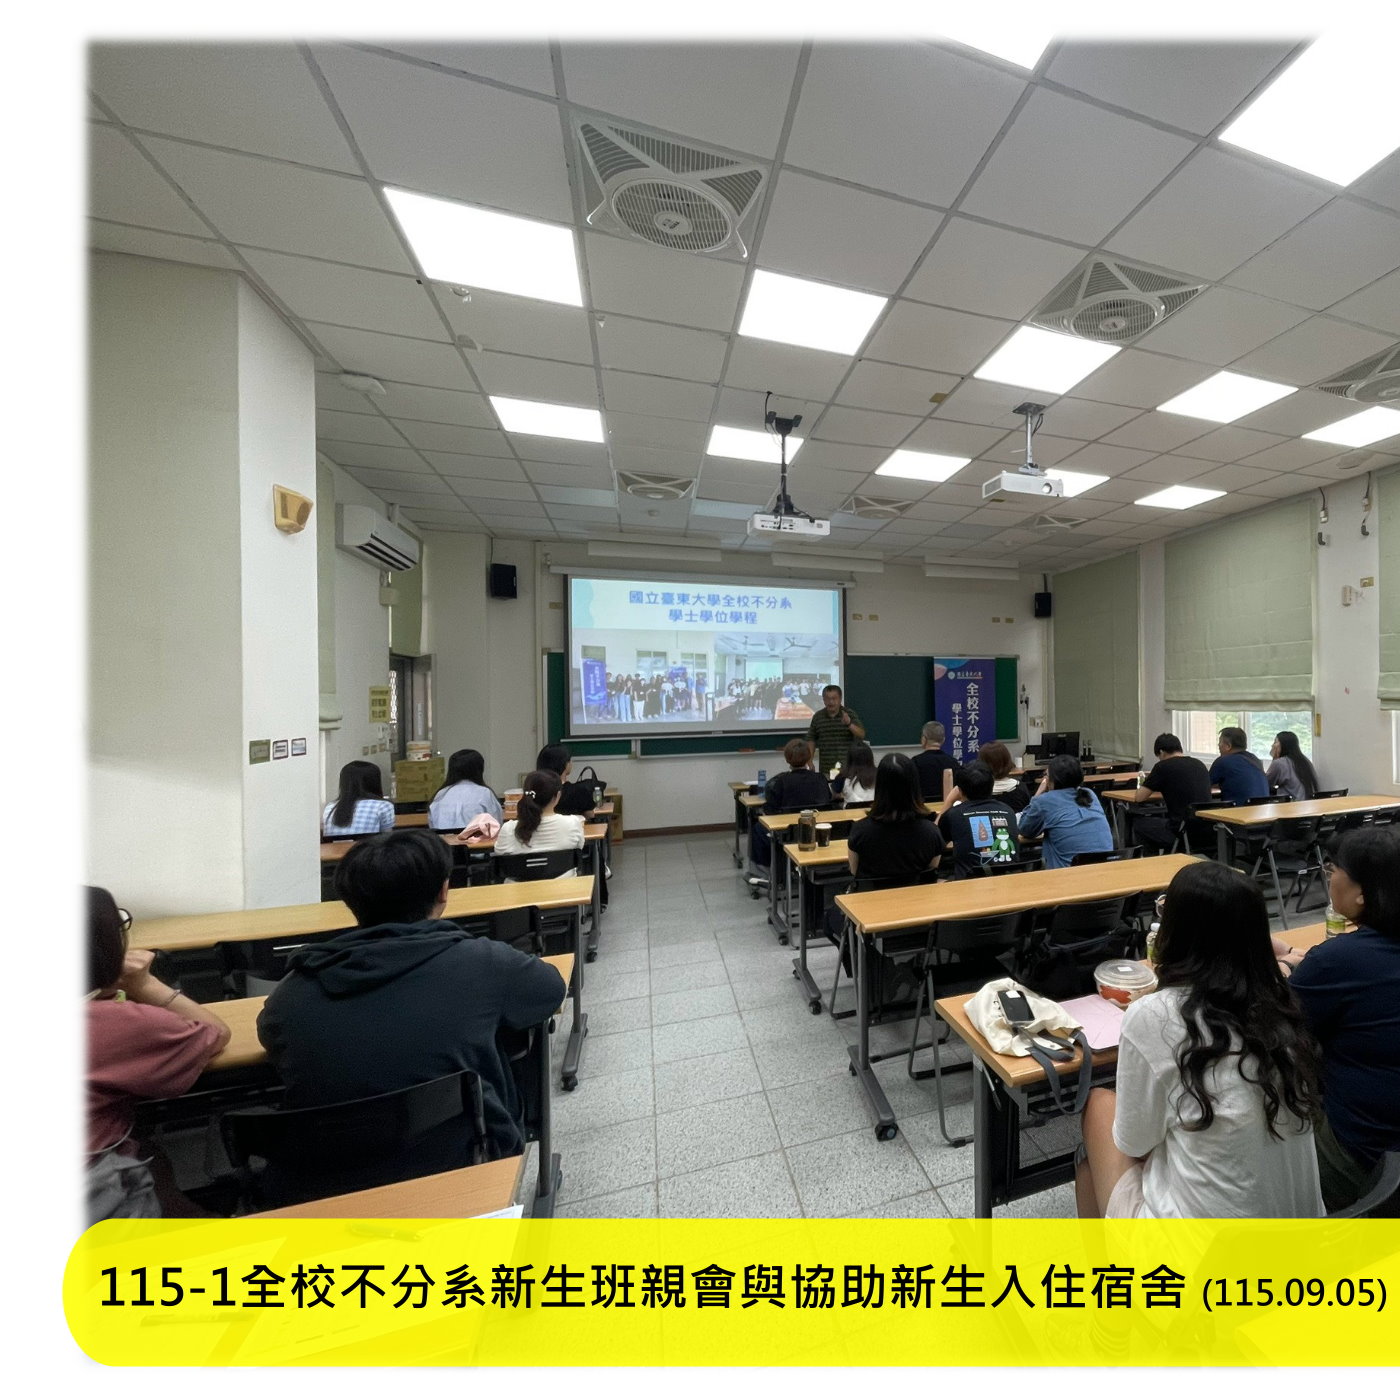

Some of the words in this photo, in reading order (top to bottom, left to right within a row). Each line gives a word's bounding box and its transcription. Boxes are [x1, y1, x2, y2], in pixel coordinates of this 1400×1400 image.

[629, 590, 793, 609] 國立臺東大學全校不分系
[668, 608, 758, 625] 學士學位學程
[966, 682, 980, 753] 全校不分系
